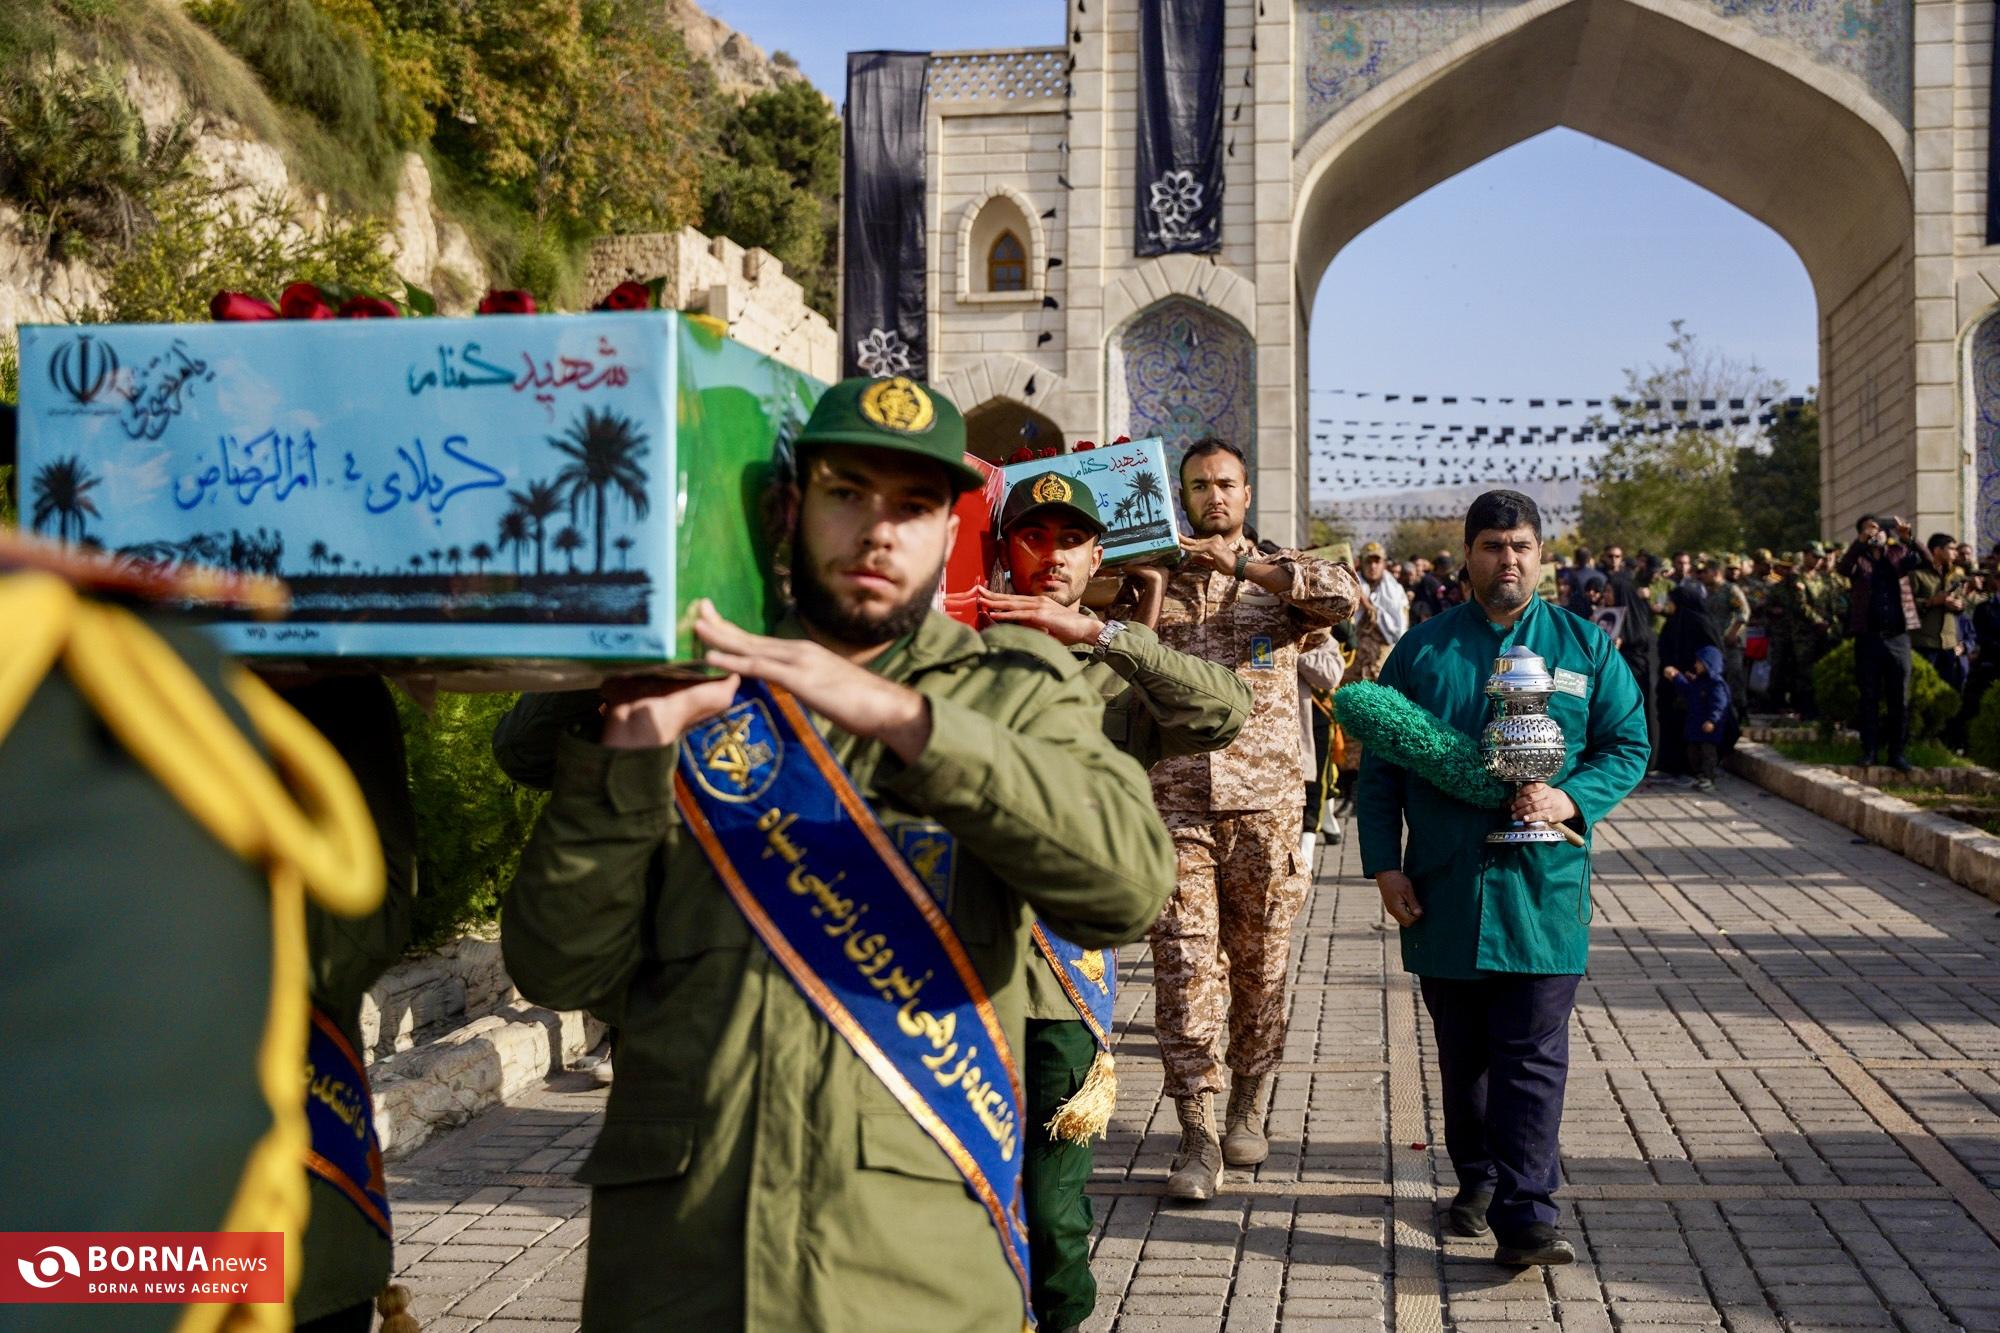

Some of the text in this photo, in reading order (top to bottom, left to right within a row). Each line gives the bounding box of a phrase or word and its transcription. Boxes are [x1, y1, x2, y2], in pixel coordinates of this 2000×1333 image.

[512, 335, 629, 403] شهید
[366, 436, 506, 526] کربلای
[1109, 449, 1149, 473] شهید
[757, 807, 1017, 1163] دانشکده زرهی نیروی زمینی سپاه
